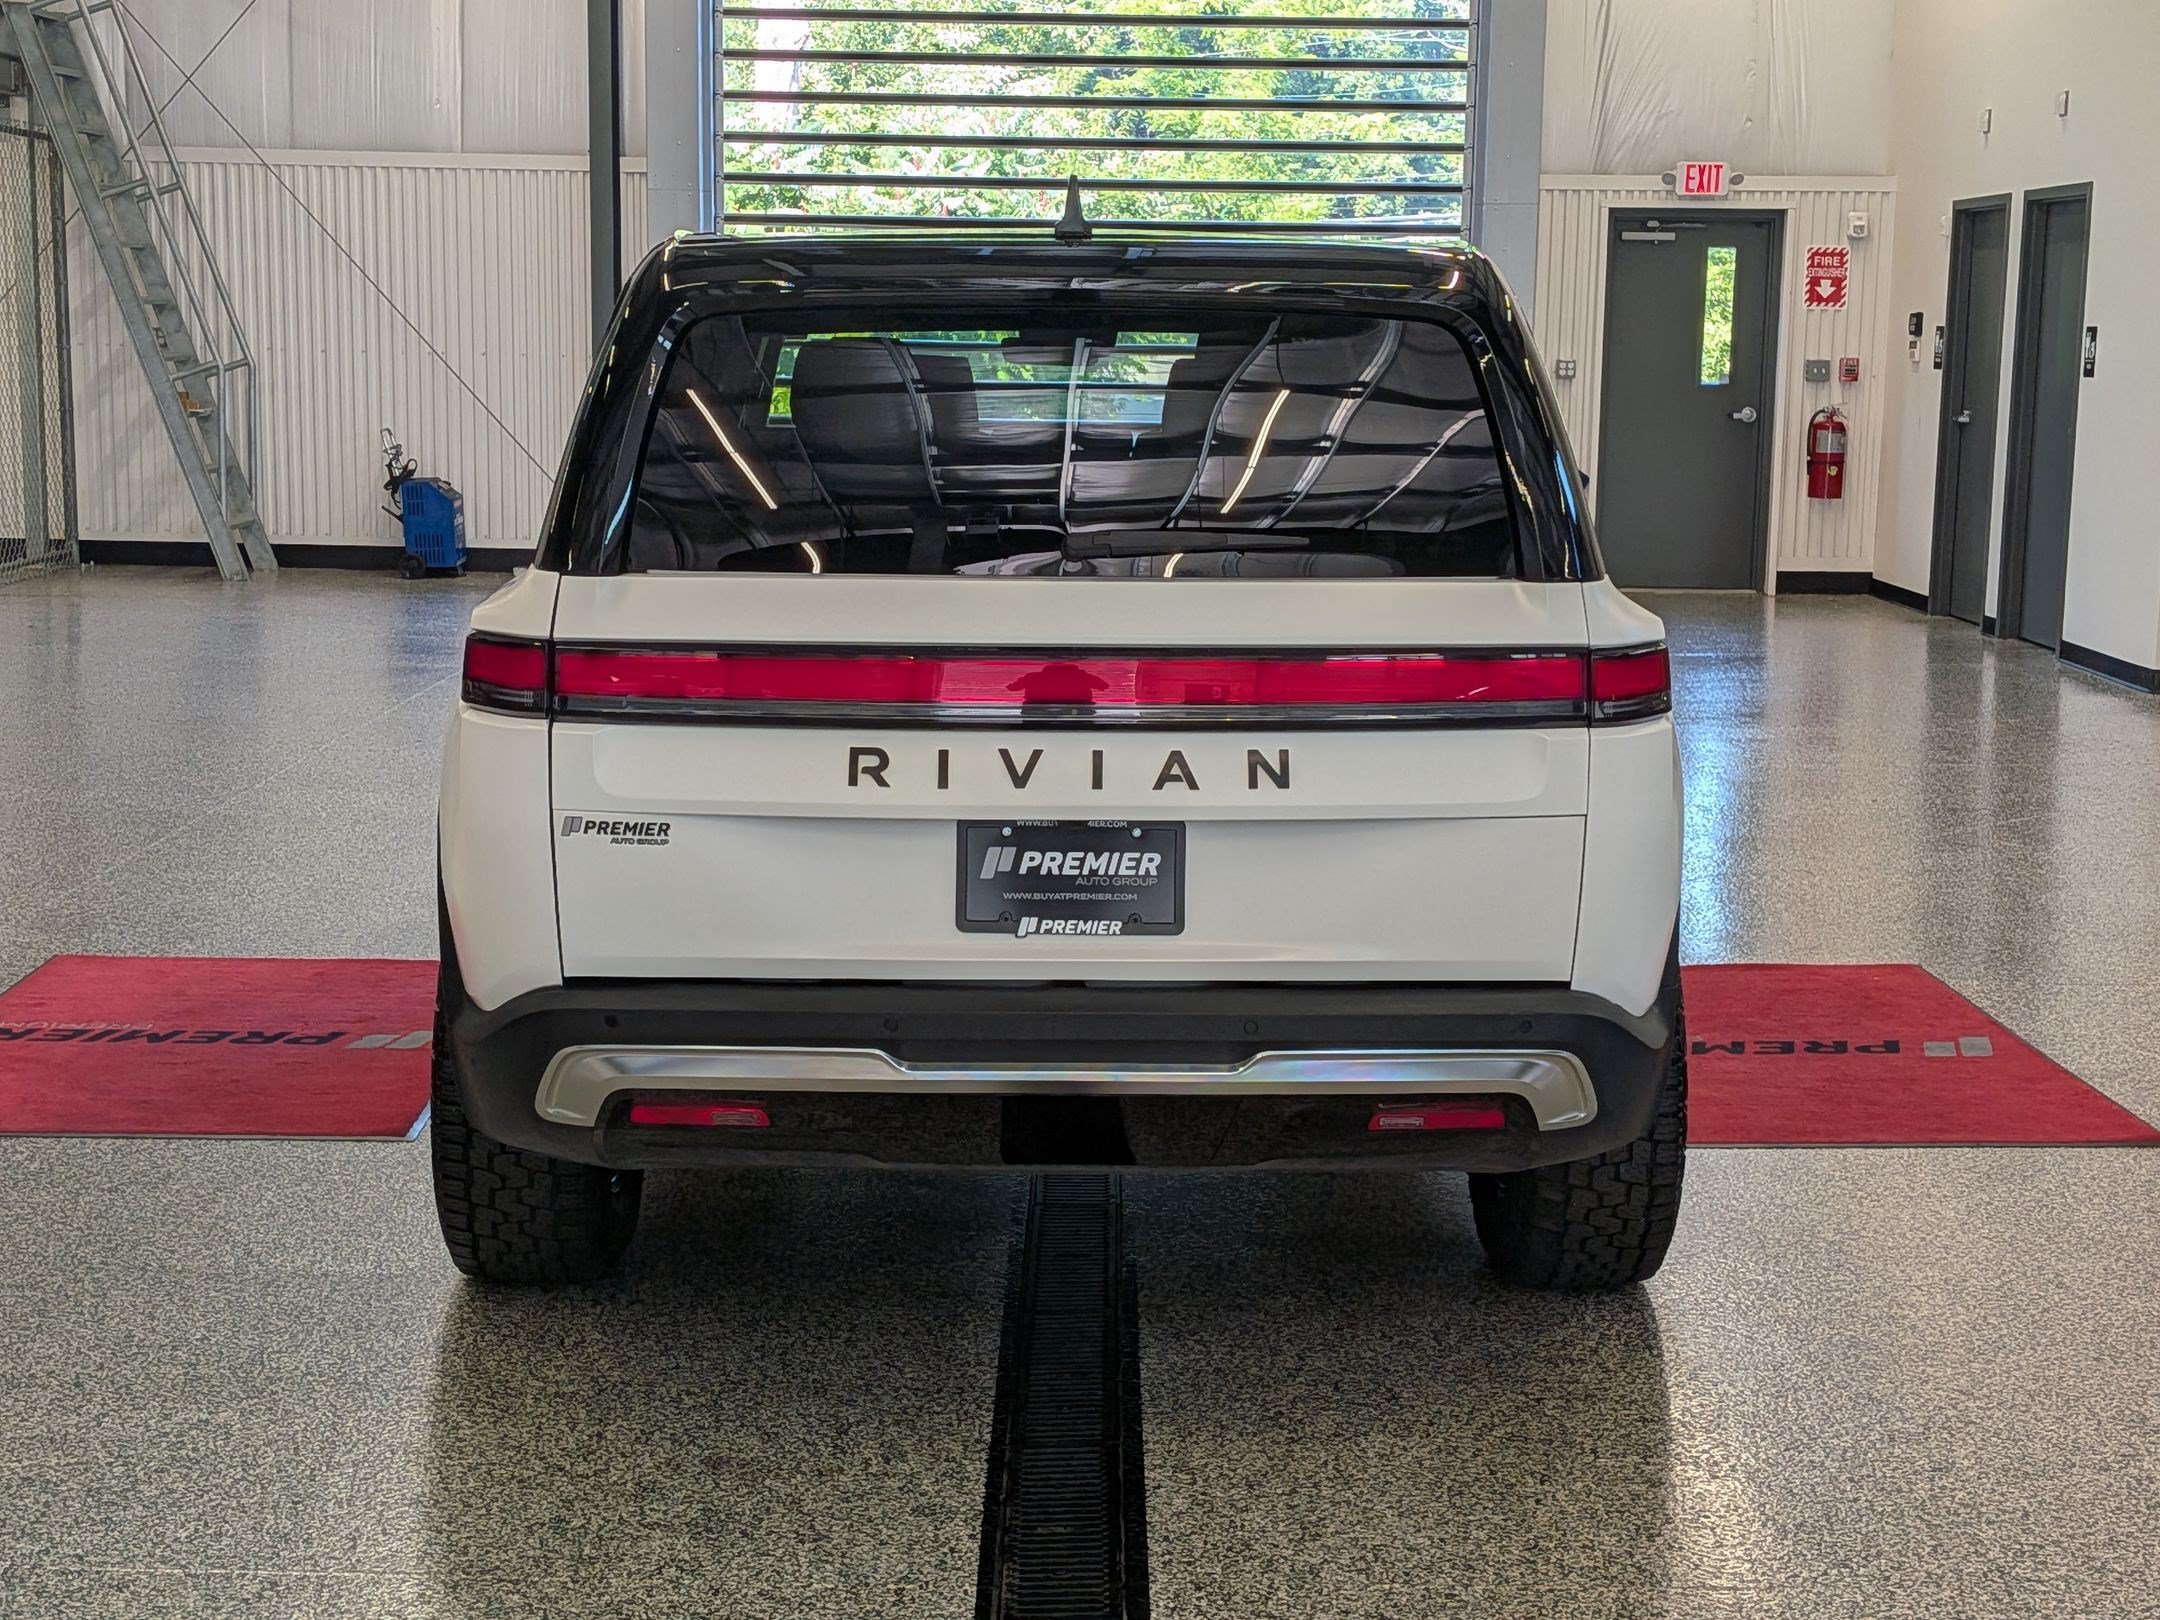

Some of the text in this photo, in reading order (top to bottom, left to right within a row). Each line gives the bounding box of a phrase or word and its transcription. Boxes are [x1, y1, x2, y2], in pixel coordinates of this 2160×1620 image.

[1684, 164, 1723, 193] EXIT
[1814, 256, 1841, 267] FIRE
[847, 746, 1291, 791] RIVIAN
[583, 820, 671, 837] PREMIER
[609, 837, 670, 846] AUTO GROUP
[1018, 851, 1162, 876] PREMIER
[1075, 877, 1158, 886] AUTO GROUP
[1003, 892, 1138, 901] WWW.BUYATPREMIER.COM
[1039, 919, 1123, 935] PREMIER
[1691, 1040, 1901, 1055] PREM
